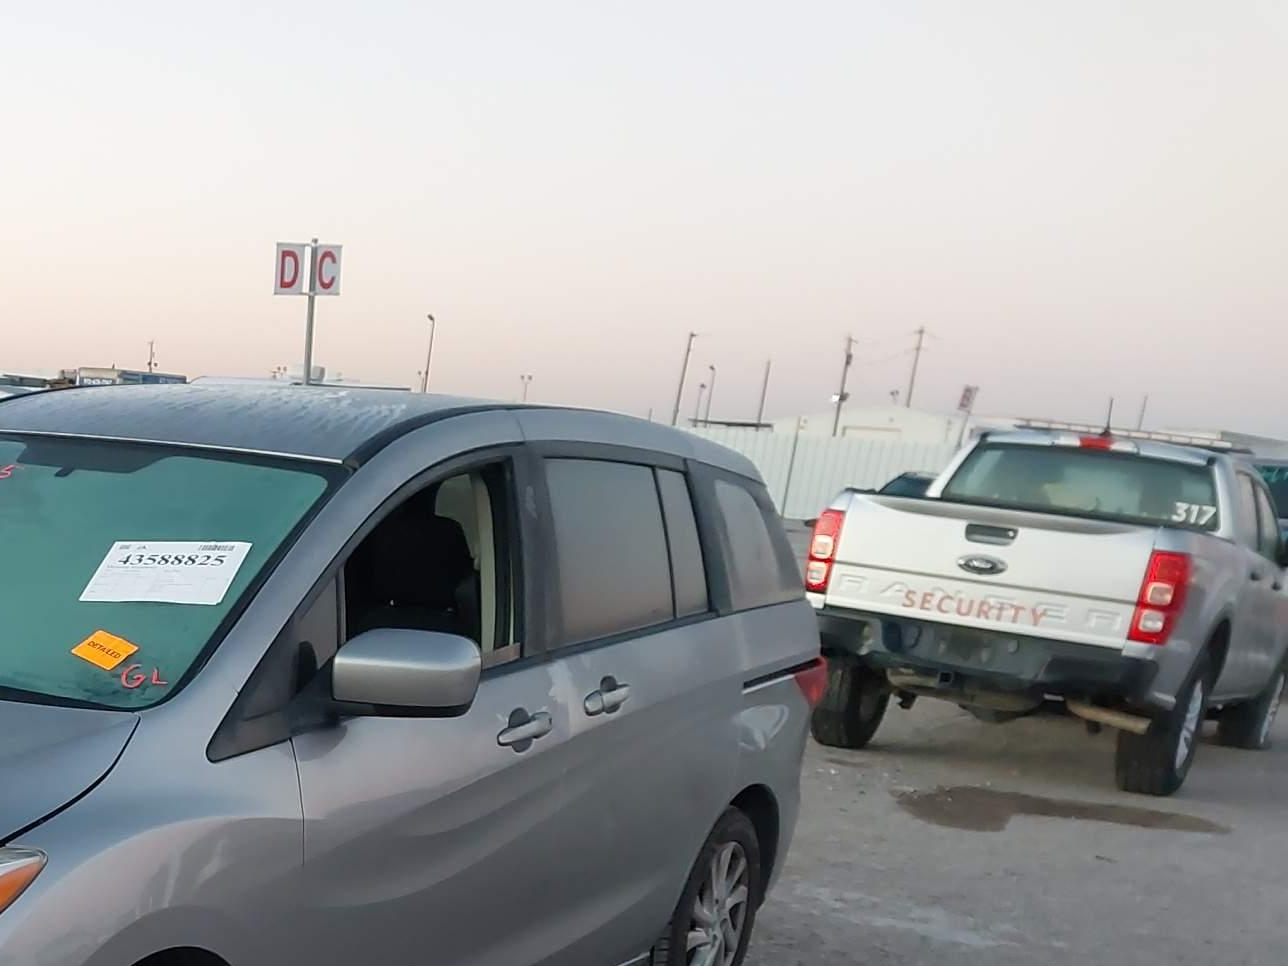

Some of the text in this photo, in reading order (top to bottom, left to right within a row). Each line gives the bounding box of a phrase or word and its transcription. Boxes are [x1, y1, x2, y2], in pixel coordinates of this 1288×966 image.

[280, 250, 337, 289] D C
[1171, 502, 1216, 525] 317
[118, 553, 228, 566] 43588825
[902, 589, 1048, 627] SECURITY
[87, 640, 121, 659] DETAILED
